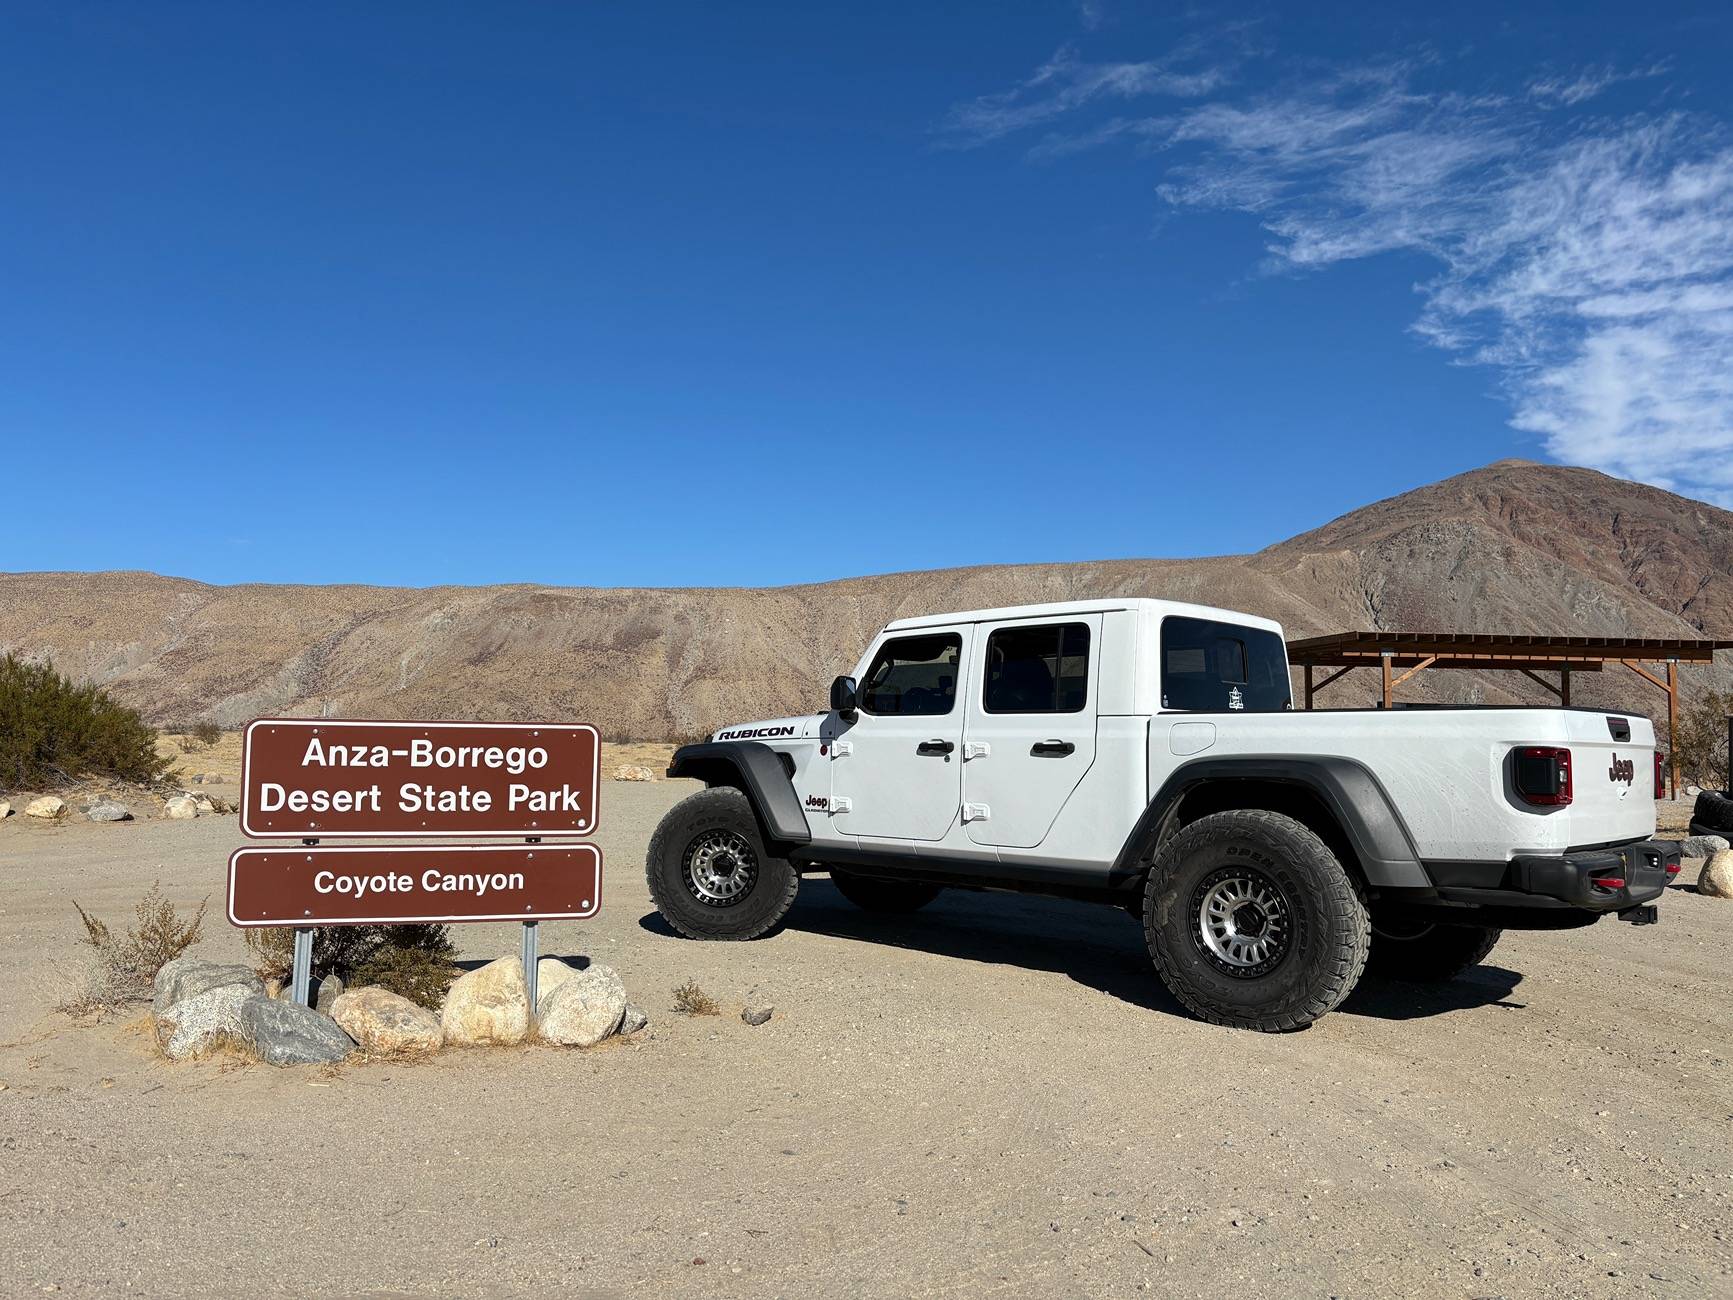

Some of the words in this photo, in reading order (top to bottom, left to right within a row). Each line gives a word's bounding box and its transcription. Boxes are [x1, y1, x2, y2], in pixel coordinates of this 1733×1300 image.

[719, 726, 795, 740] RUBICON
[302, 738, 547, 774] Anza-Borrego
[1609, 752, 1634, 787] Jeep
[261, 784, 381, 811] Desert
[399, 783, 491, 812] State
[509, 784, 580, 811] Park
[805, 794, 828, 809] Jeep
[315, 871, 413, 898] Coyote
[422, 870, 523, 896] Canyon
